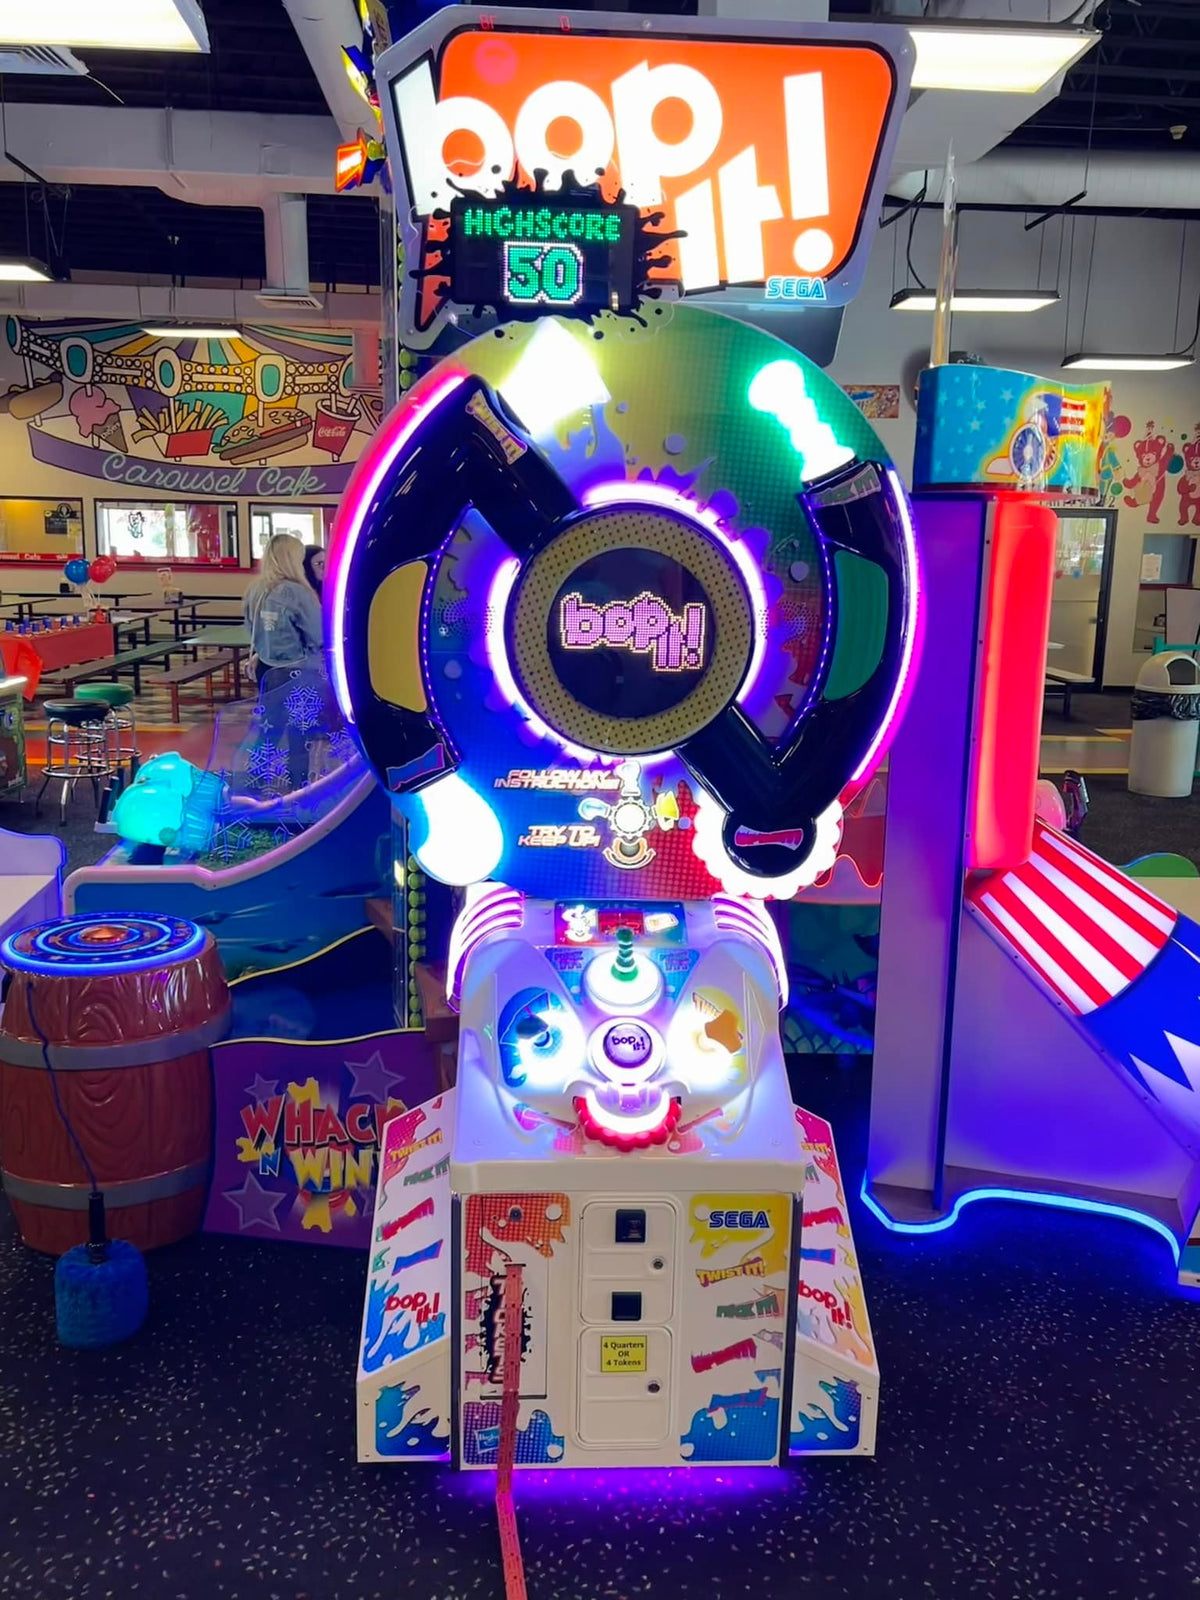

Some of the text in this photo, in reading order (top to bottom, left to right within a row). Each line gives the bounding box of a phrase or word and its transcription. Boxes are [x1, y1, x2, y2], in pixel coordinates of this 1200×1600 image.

[393, 60, 722, 216] bop
[503, 240, 583, 304] 50
[765, 276, 827, 300] SEGA
[101, 453, 326, 497] Carousel Cafe
[560, 592, 672, 653] bop
[508, 769, 580, 780] FOLLOW
[518, 835, 601, 847] KEEP UP!
[528, 825, 595, 836] TRY TO
[611, 1035, 636, 1045] bop
[291, 1147, 373, 1192] WIN
[709, 1210, 770, 1229] SEGA
[696, 1264, 744, 1287] TWIST
[385, 1291, 427, 1311] bop
[797, 1280, 838, 1309] bop
[611, 1342, 644, 1350] Quarters
